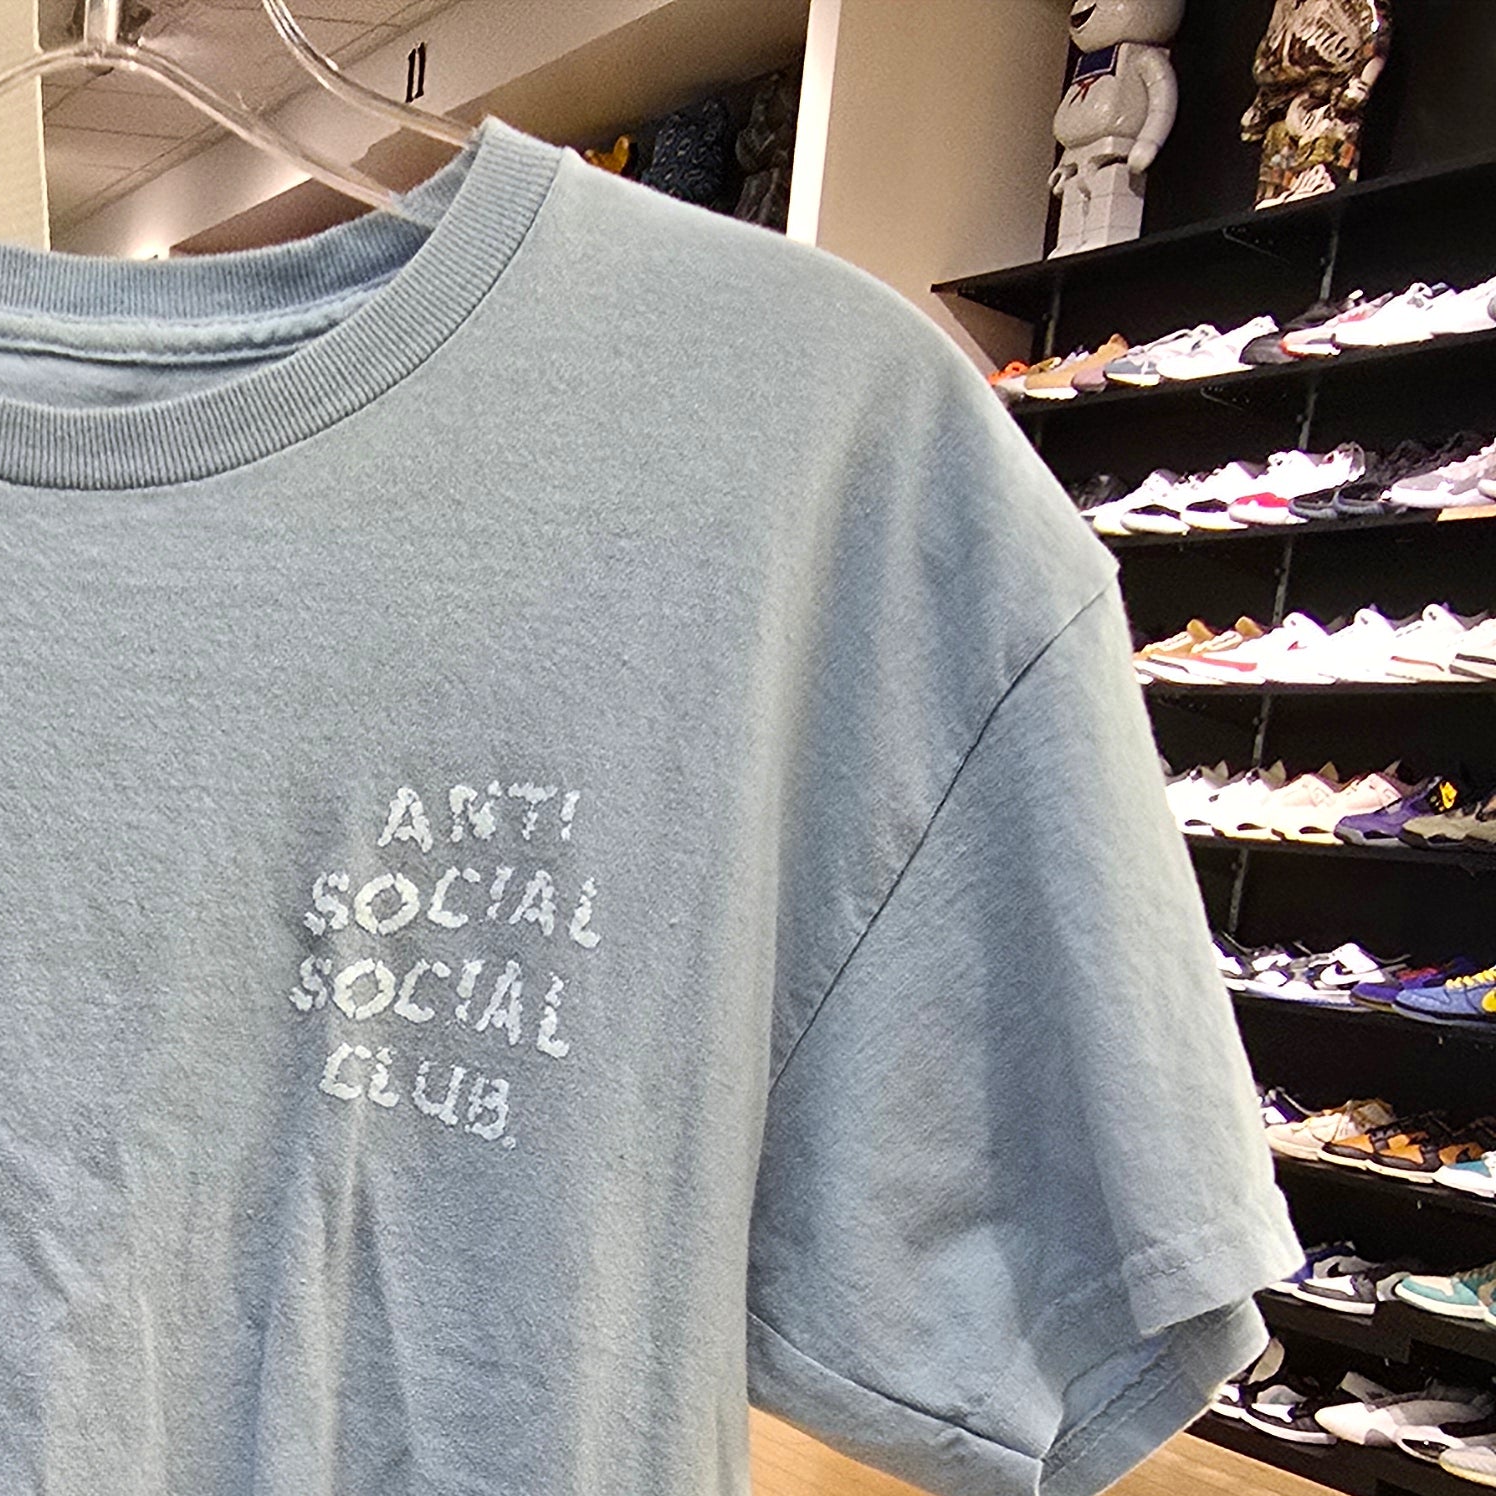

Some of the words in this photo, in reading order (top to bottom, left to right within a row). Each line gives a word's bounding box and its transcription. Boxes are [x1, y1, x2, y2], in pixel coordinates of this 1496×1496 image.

[377, 780, 581, 853] ANTI
[303, 866, 602, 948] SOCIAL
[289, 956, 571, 1059] SOCIAL
[319, 1042, 515, 1147] CLUB
